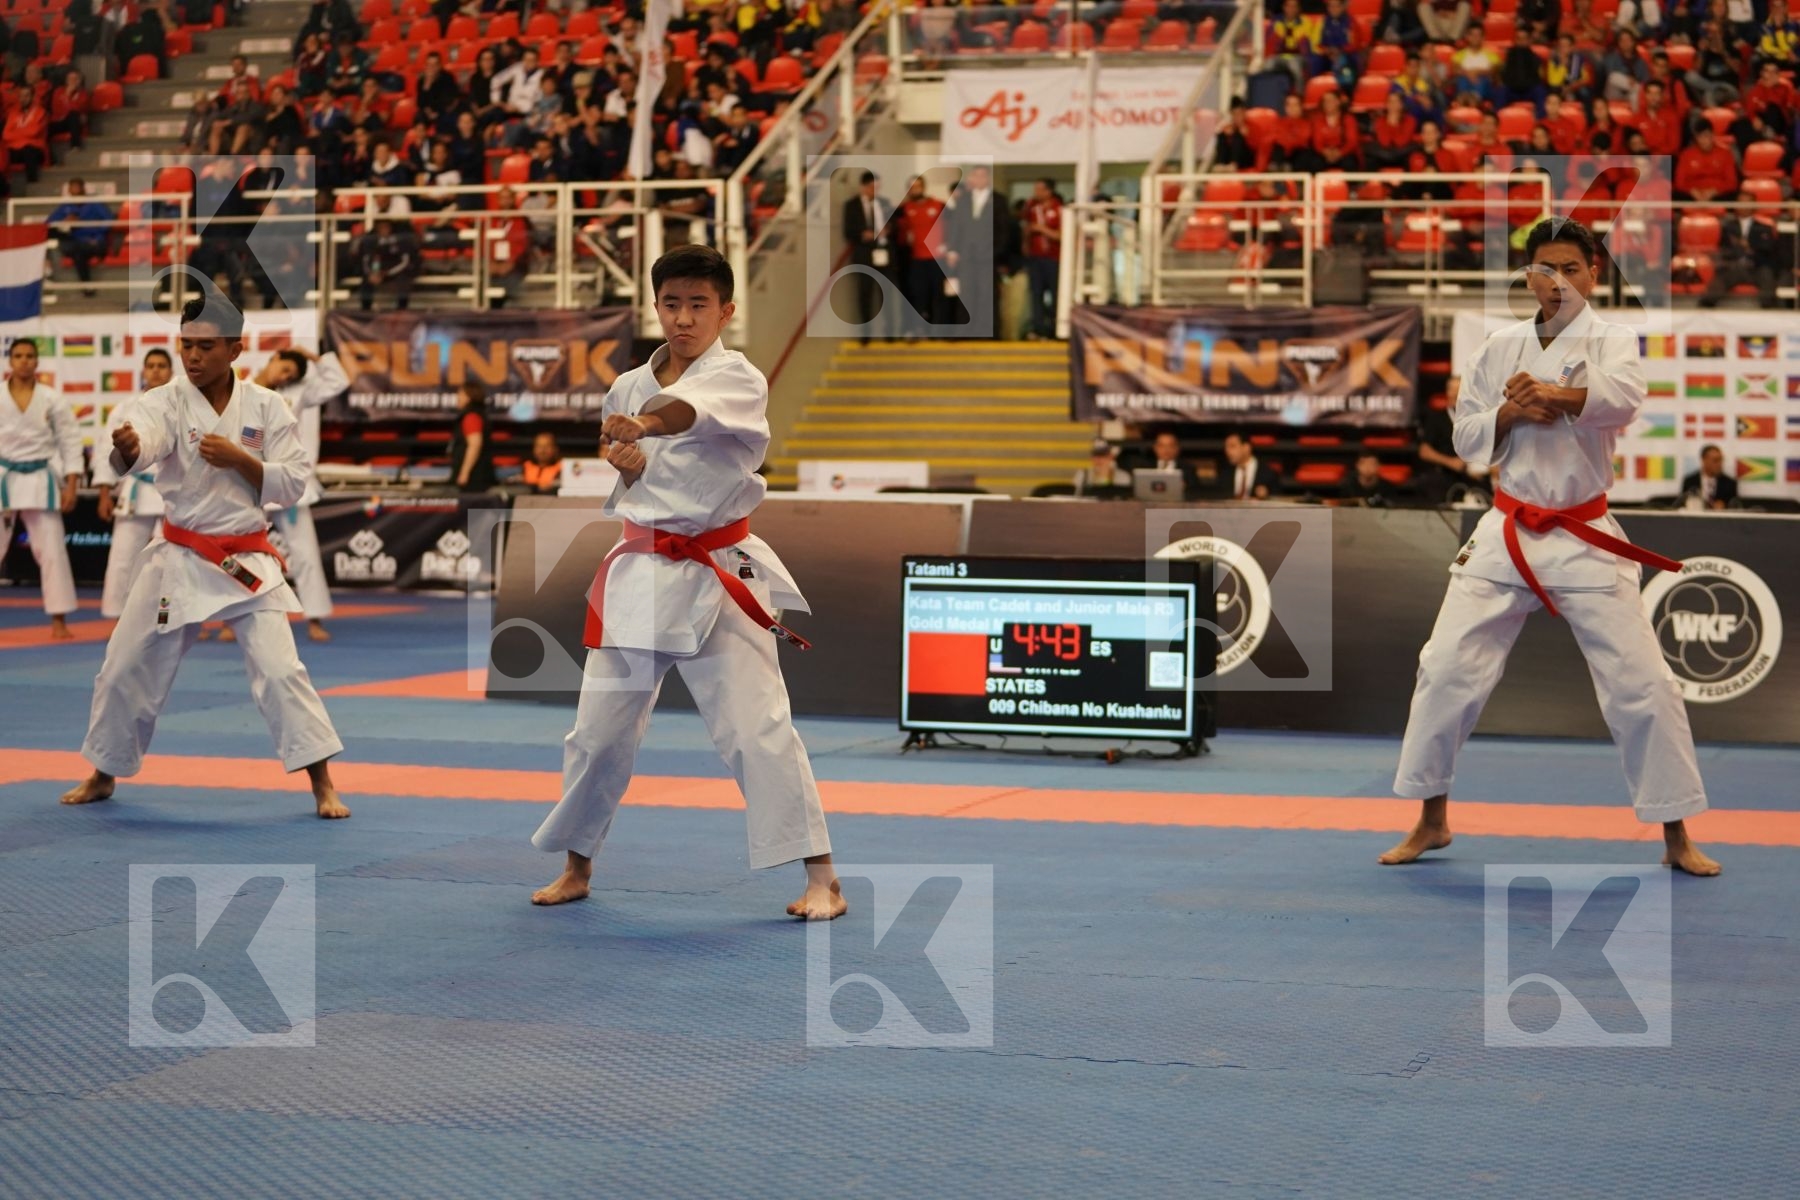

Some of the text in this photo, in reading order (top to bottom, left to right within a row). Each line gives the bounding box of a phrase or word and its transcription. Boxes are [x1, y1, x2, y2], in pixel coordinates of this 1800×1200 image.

[1178, 540, 1228, 555] WORLD
[906, 562, 968, 577] Tatami 3
[1681, 561, 1732, 575] WORLD
[909, 596, 1175, 616] Kata Team Cadet and Junior Male R3
[909, 615, 943, 630] Gold
[947, 617, 990, 631] Medal
[1672, 613, 1738, 643] WKF
[1012, 623, 1081, 661] 4:43
[1697, 653, 1771, 697] FEDERATION
[985, 678, 1046, 695] STATES
[989, 699, 1182, 720] 009 Chibana No Kushanku
